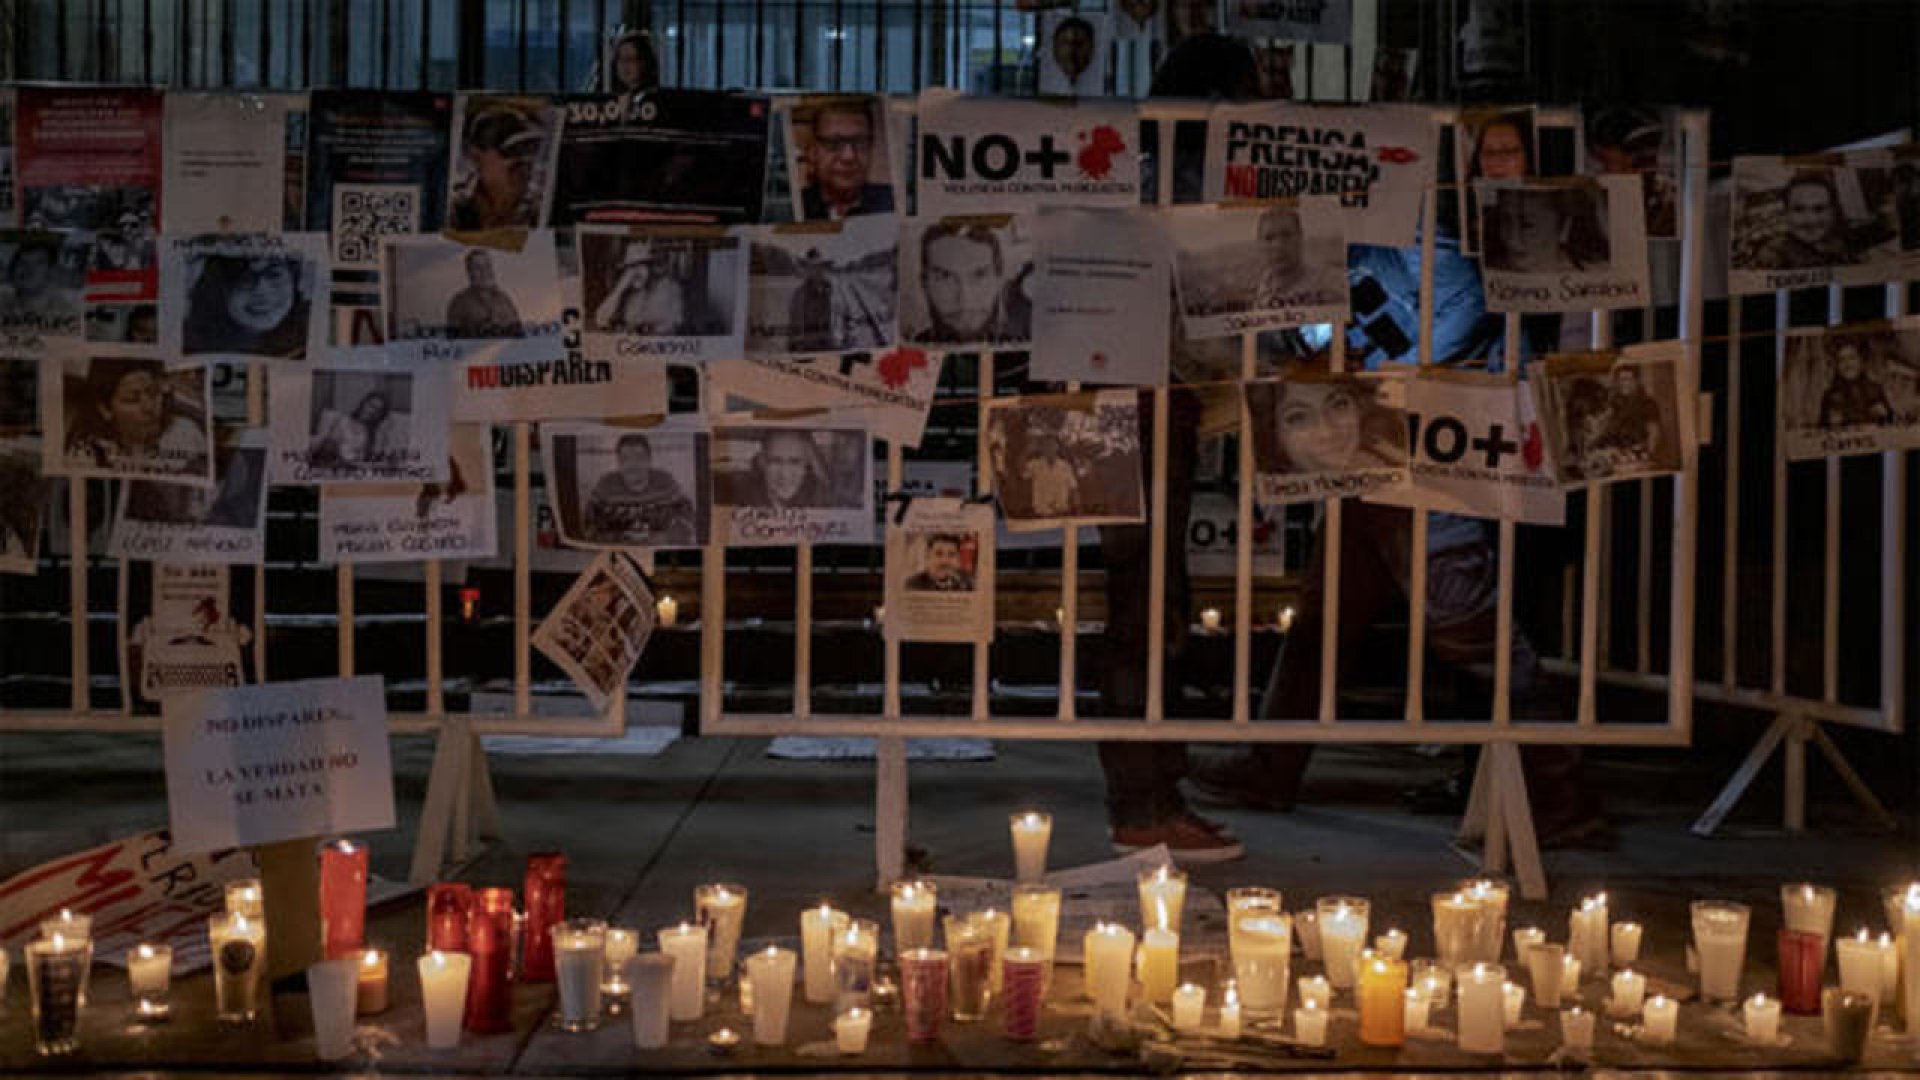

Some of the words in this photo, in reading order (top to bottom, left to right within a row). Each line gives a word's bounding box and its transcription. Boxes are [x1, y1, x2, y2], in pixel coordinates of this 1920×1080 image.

[205, 716, 238, 733] NO
[205, 769, 234, 786] LA
[237, 759, 324, 783] VERDAD
[328, 752, 359, 769] NO
[235, 791, 254, 805] SE
[264, 782, 323, 803] MATA
